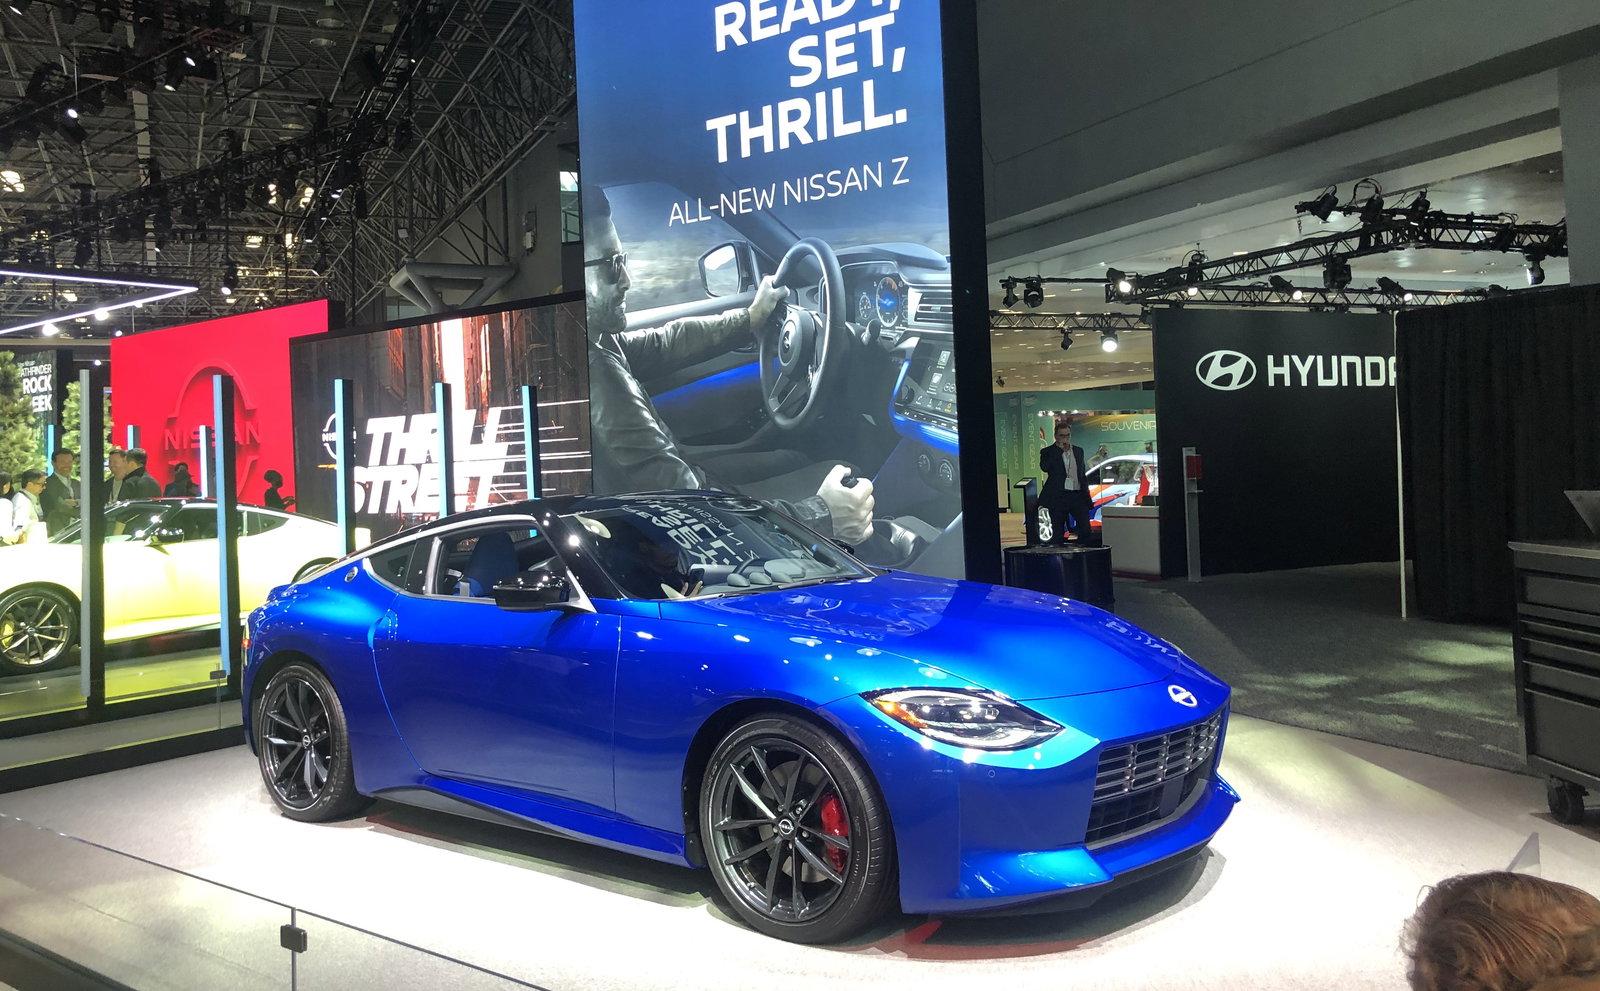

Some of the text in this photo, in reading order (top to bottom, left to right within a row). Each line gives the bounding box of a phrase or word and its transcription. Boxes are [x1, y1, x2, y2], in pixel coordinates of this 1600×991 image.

[788, 12, 906, 88] SET,
[706, 79, 908, 164] THRILL.
[668, 156, 910, 227] ALL-NEW NISSAN Z
[19, 363, 52, 378] ATHFINDER
[22, 373, 53, 395] ROCK
[1267, 354, 1397, 387] HYUND
[31, 393, 53, 413] EEK
